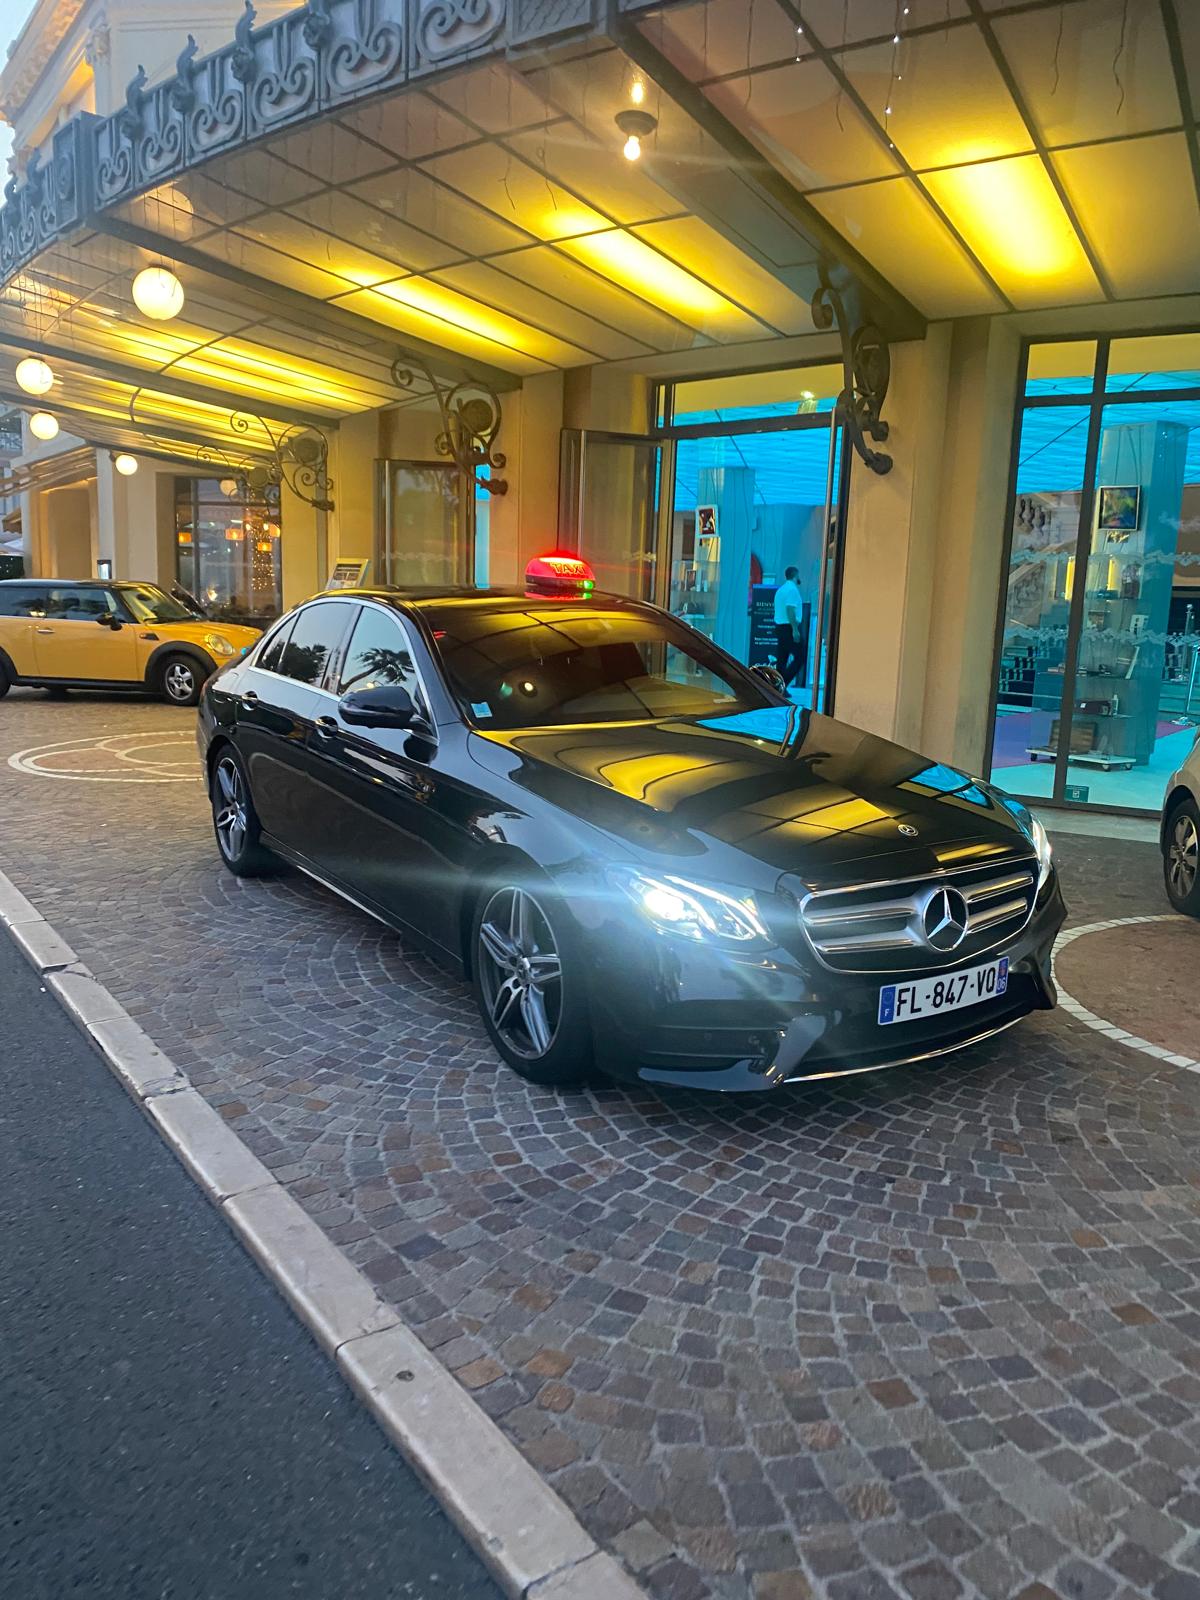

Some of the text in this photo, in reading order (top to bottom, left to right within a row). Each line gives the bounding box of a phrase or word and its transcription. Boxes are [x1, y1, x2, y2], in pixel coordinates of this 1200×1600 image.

[551, 562, 587, 575] TAXI
[884, 967, 1006, 1017] F FL-847-VQ 06
